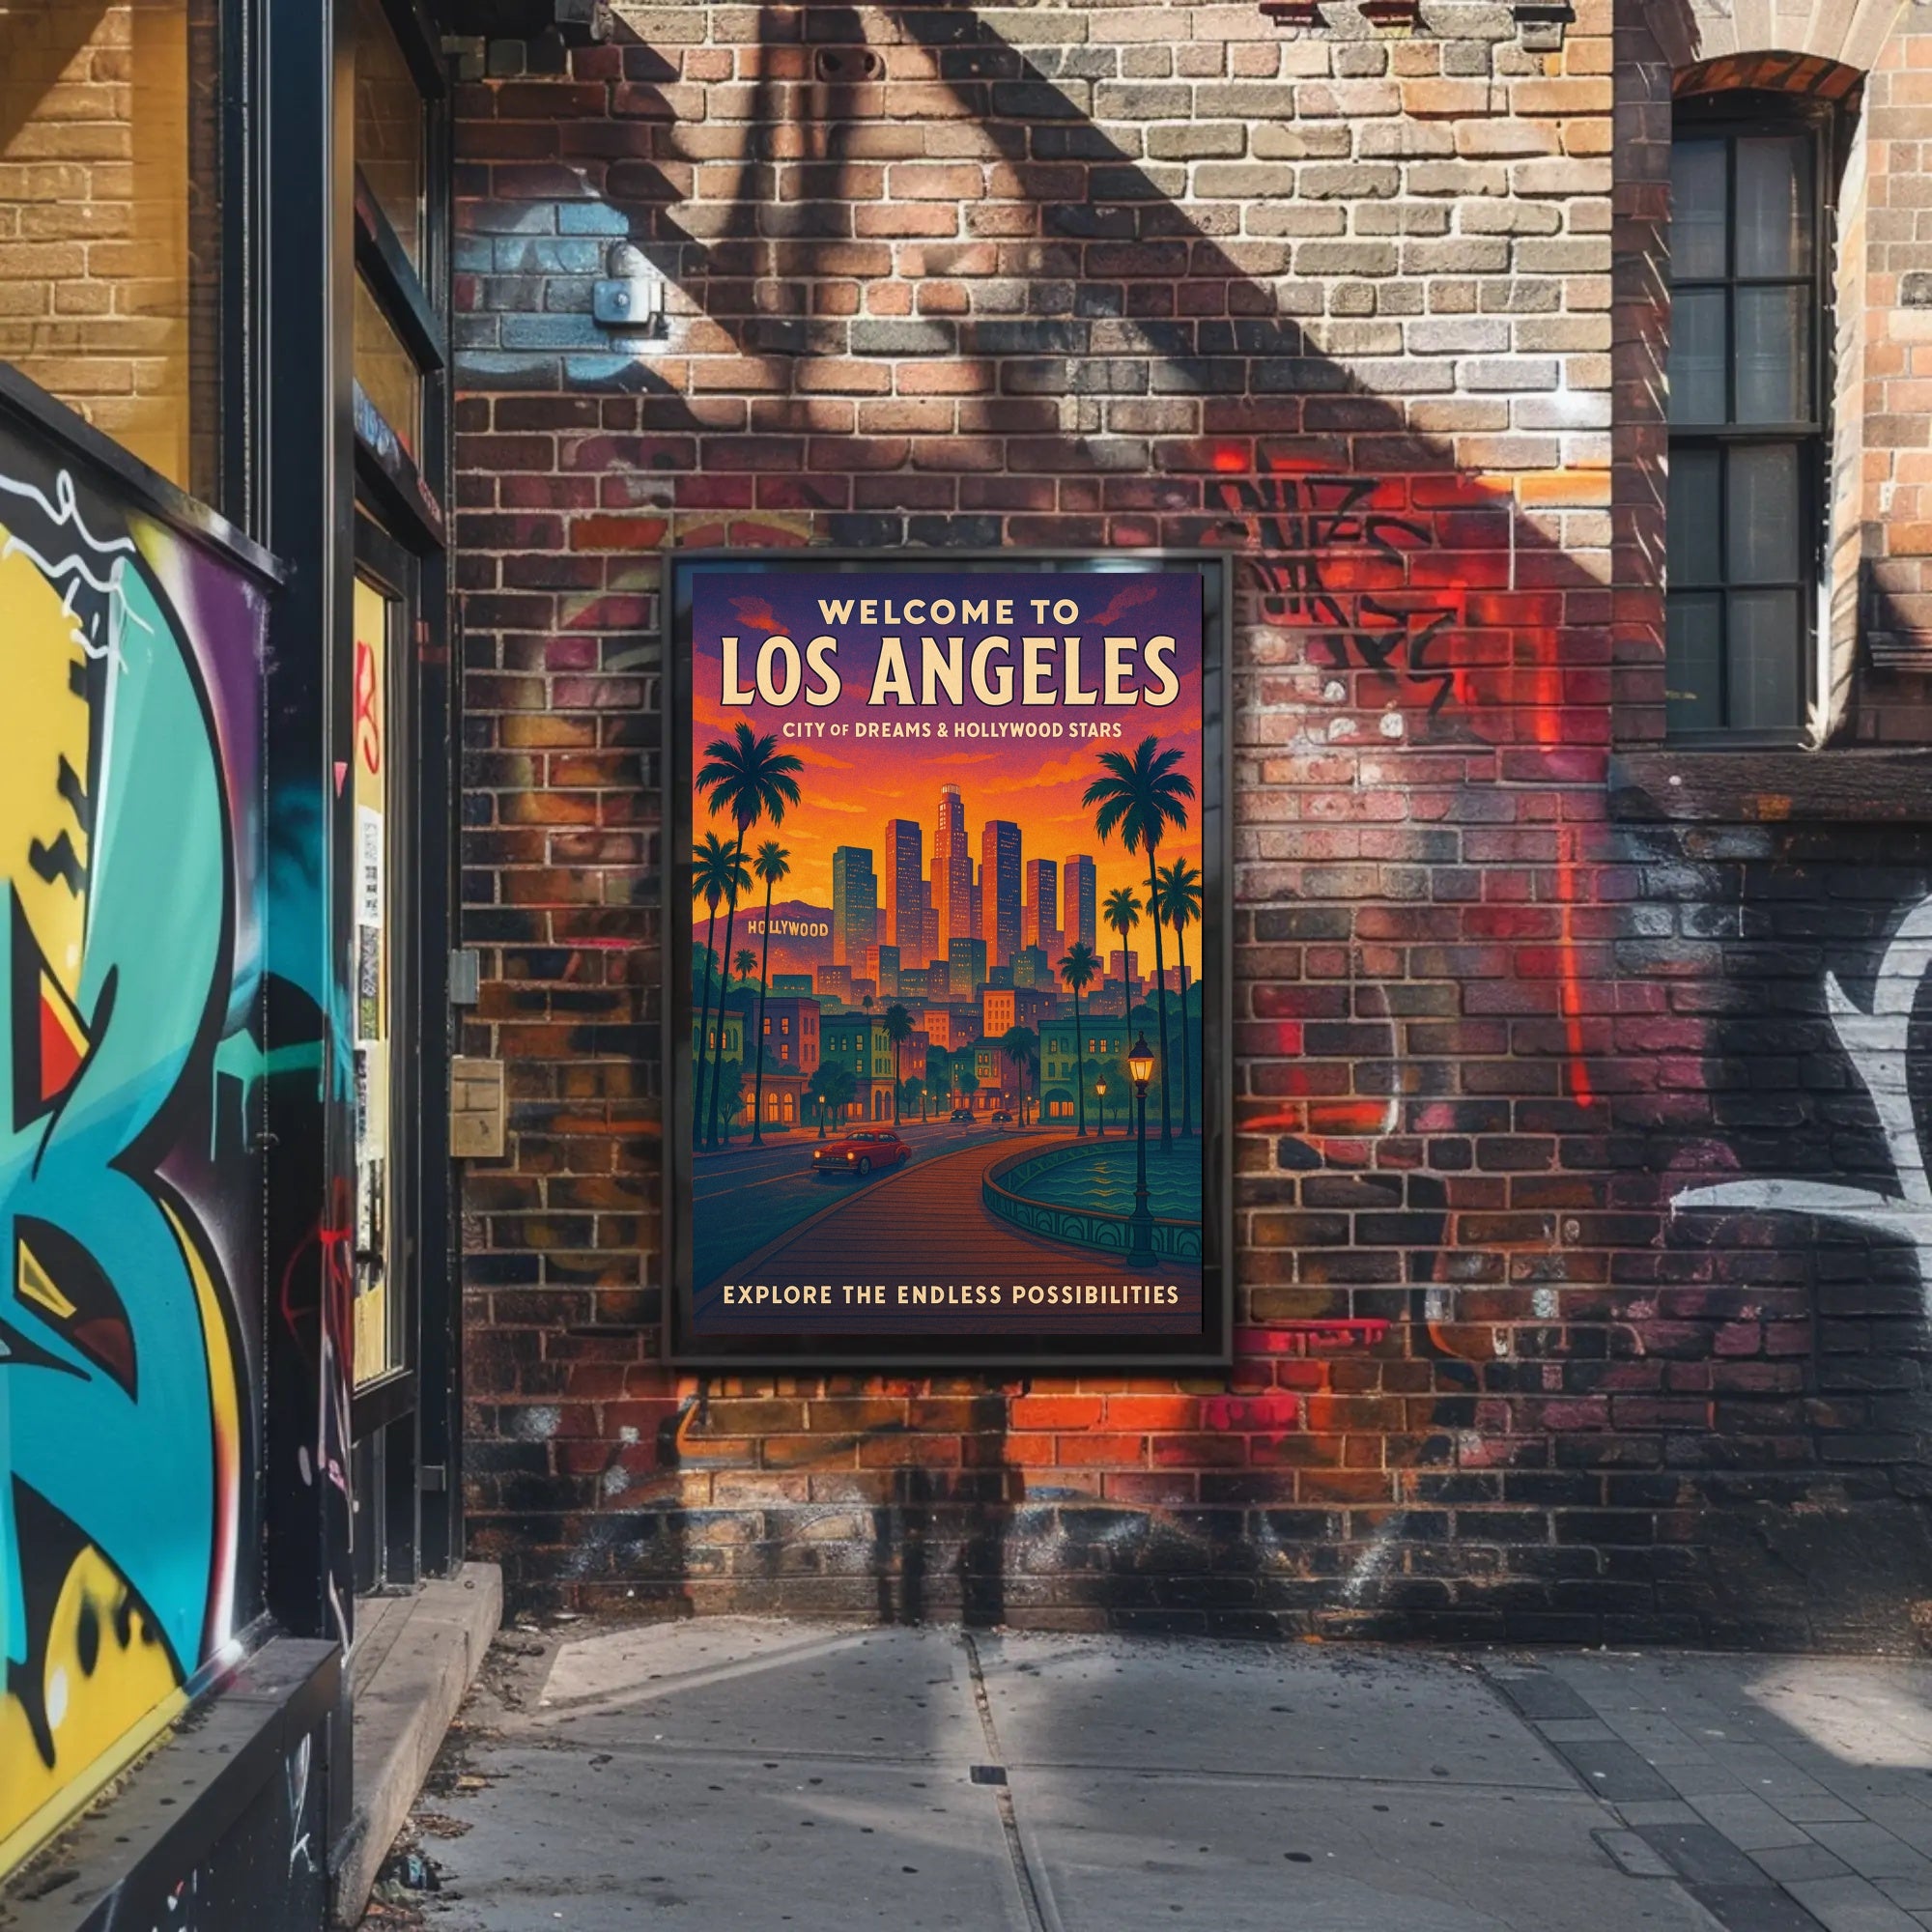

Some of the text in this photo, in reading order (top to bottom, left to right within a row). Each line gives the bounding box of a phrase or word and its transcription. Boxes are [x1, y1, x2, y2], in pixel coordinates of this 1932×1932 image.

[817, 599, 1079, 625] WELCOME TO
[721, 636, 1180, 707] LOS ANGELES
[781, 722, 825, 738] CITY
[855, 722, 931, 738] DREAMS
[936, 722, 949, 738] &
[953, 722, 1065, 738] HOLLYWOOD
[1068, 722, 1122, 738] STARS
[748, 920, 829, 937] HOLLYWOOD
[723, 1285, 1179, 1304] EXPLORE THE ENDLESS POSSIBILITIES
